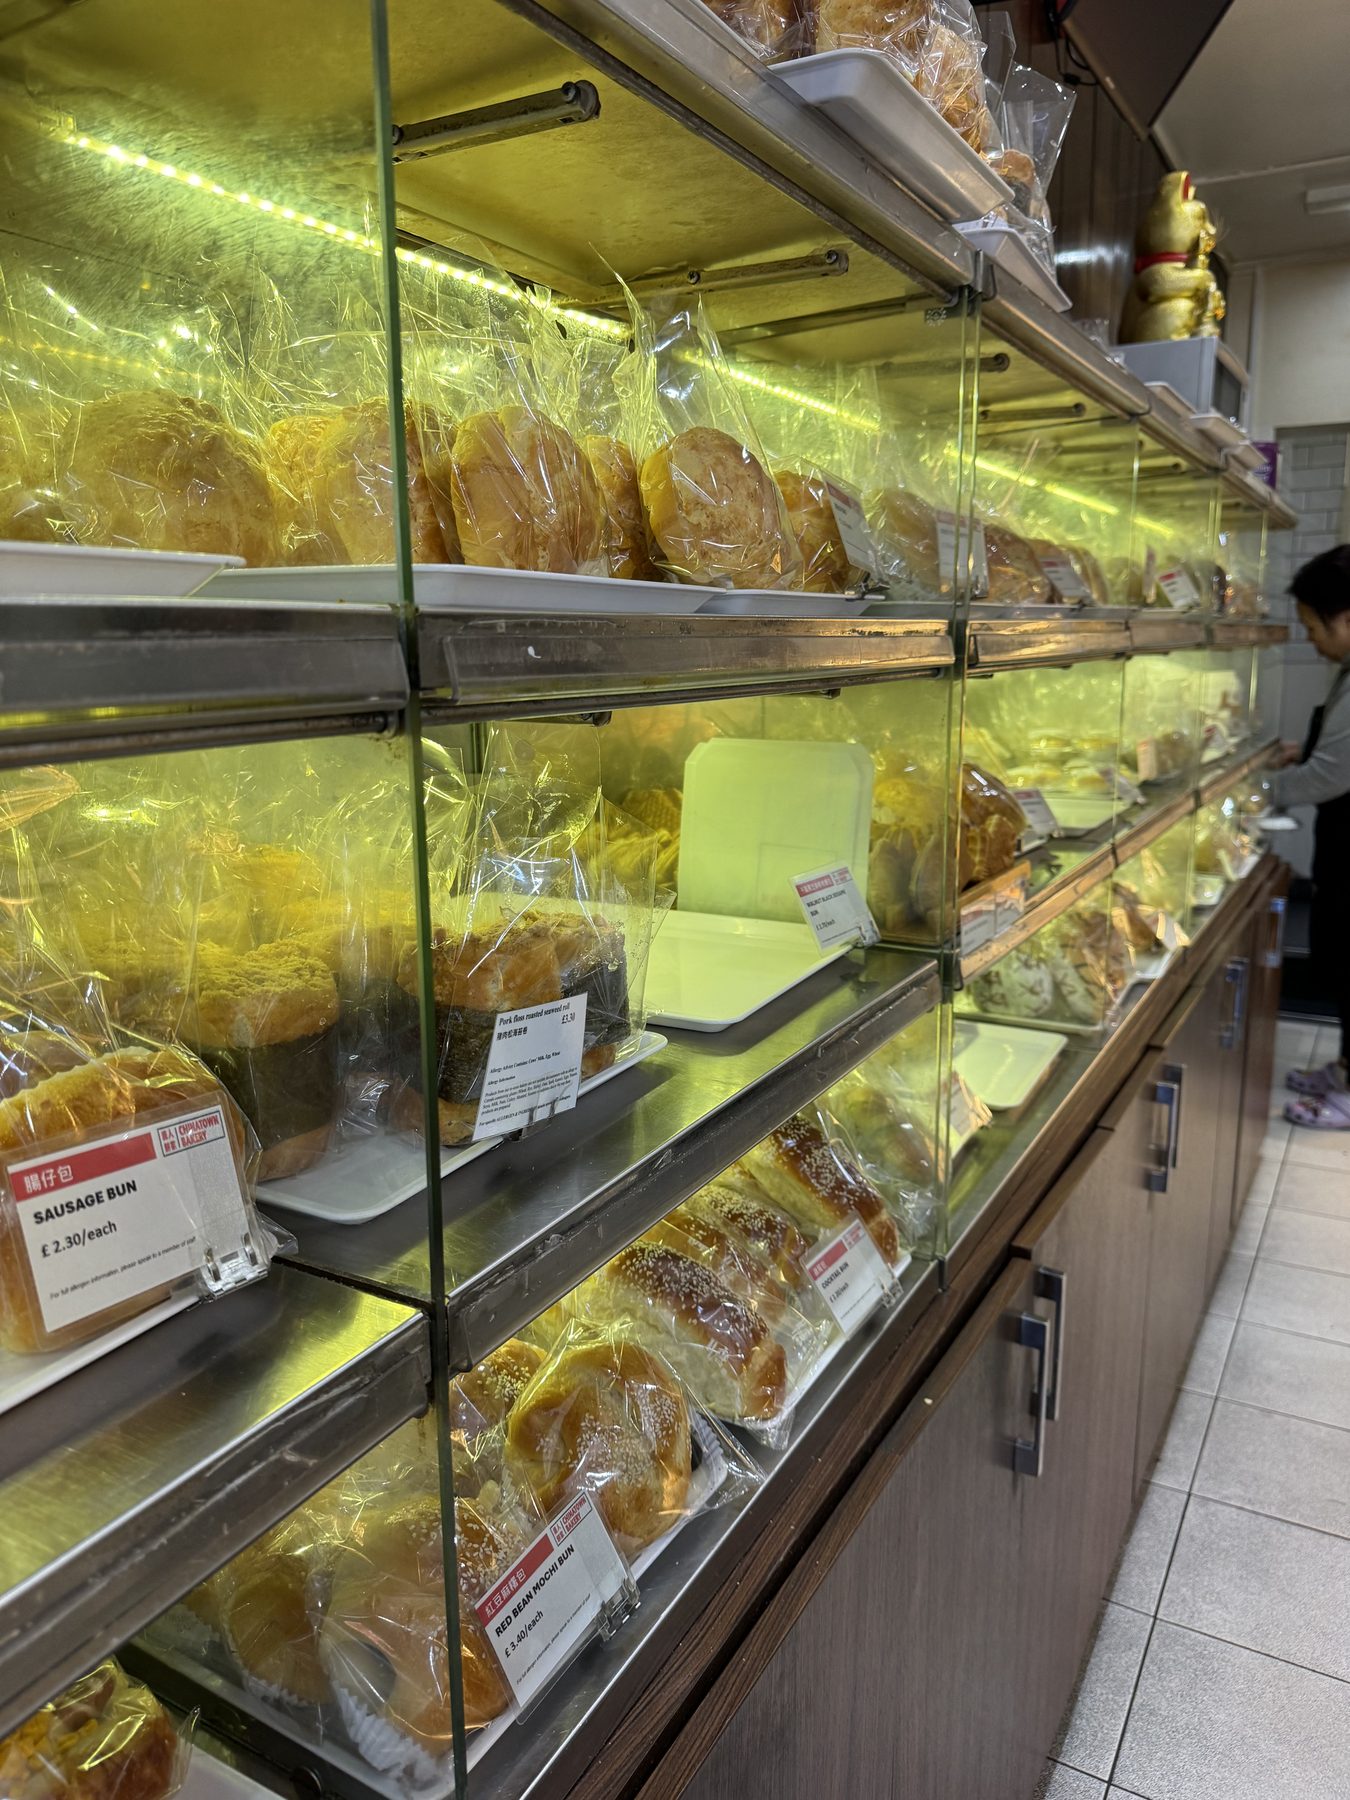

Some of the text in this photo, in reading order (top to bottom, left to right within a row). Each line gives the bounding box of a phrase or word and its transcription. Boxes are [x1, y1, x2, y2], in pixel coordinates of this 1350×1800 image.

[499, 1002, 571, 1026] Pork floss roasted seaweed roll
[178, 1114, 219, 1135] CHINATOWN
[180, 1130, 207, 1147] BAKERY
[24, 1164, 73, 1193] 腸仔包
[33, 1180, 137, 1225] SAUSAGE BUN
[41, 1220, 118, 1258] £ 2.30/each
[562, 1495, 587, 1525] CHINATOWN
[565, 1511, 582, 1532] BAKERY
[494, 1544, 575, 1638] RED BEAN MOCHI BUN
[504, 1609, 545, 1658] £ 3.40/each
